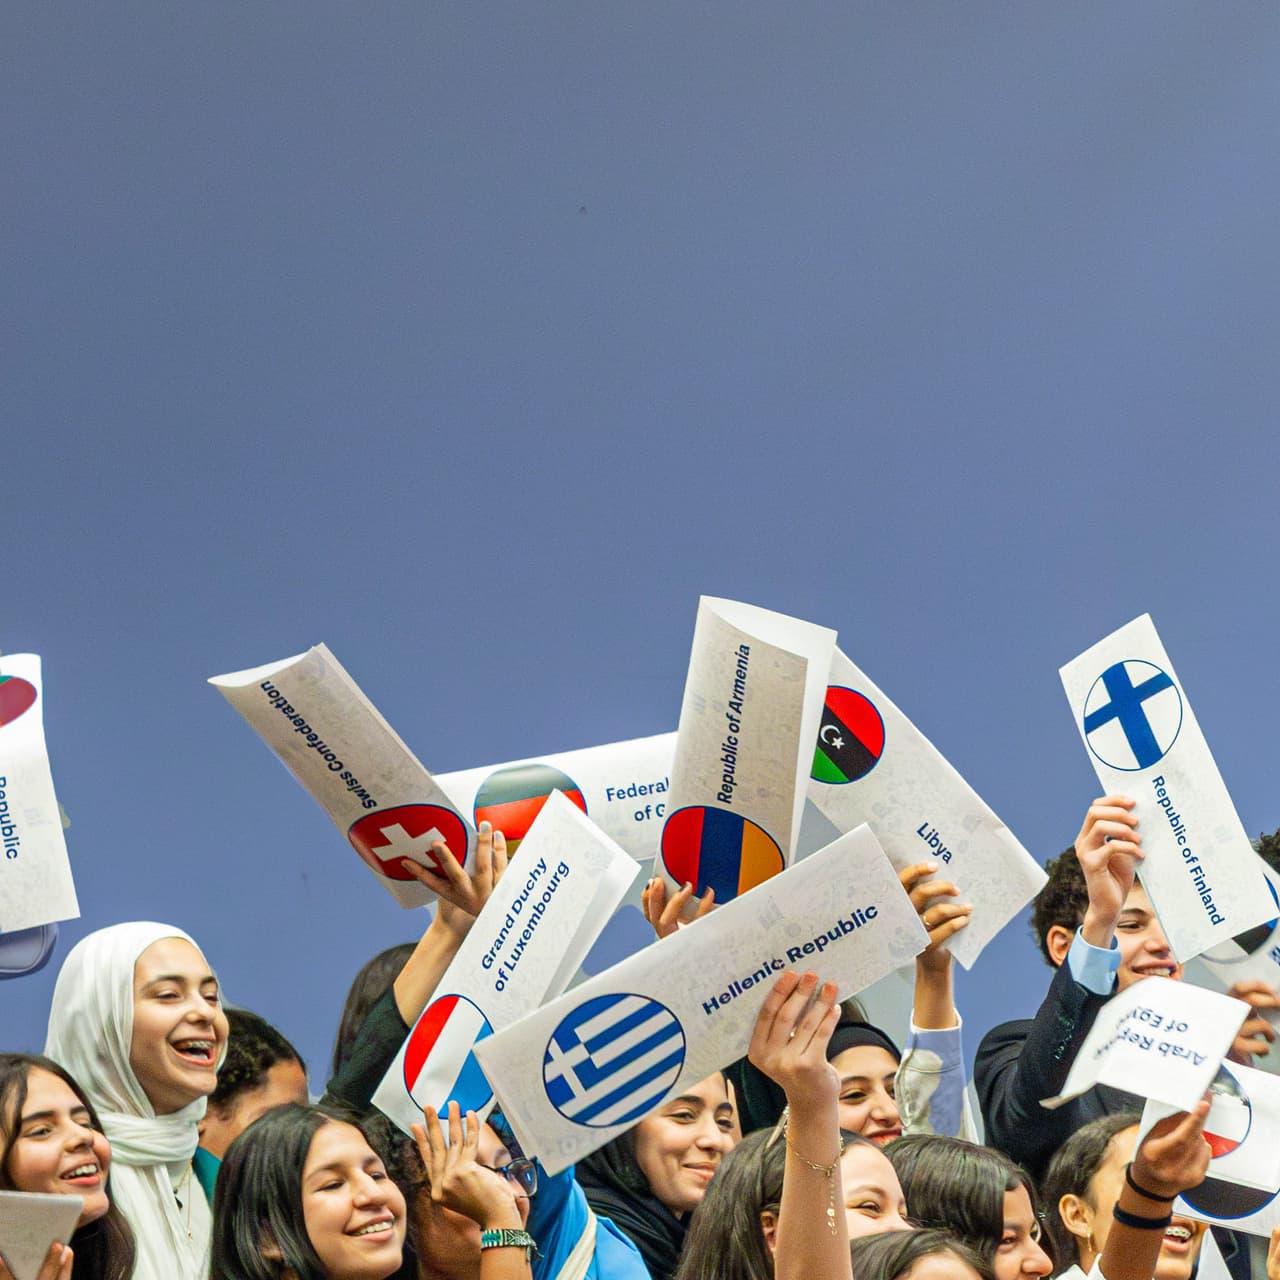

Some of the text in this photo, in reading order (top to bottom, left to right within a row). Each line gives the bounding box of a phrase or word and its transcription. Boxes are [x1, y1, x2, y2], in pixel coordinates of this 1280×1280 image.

[260, 681, 377, 809] Swiss Confederation
[717, 644, 750, 804] Republic of Armenia
[606, 777, 669, 801] Federal
[634, 805, 651, 821] of
[916, 822, 952, 865] Libya
[1152, 775, 1225, 926] Republic of Finland
[482, 858, 547, 970] Grand Duchy
[495, 861, 570, 992] of Luxembourg
[702, 905, 878, 1015] Hellenic Republic
